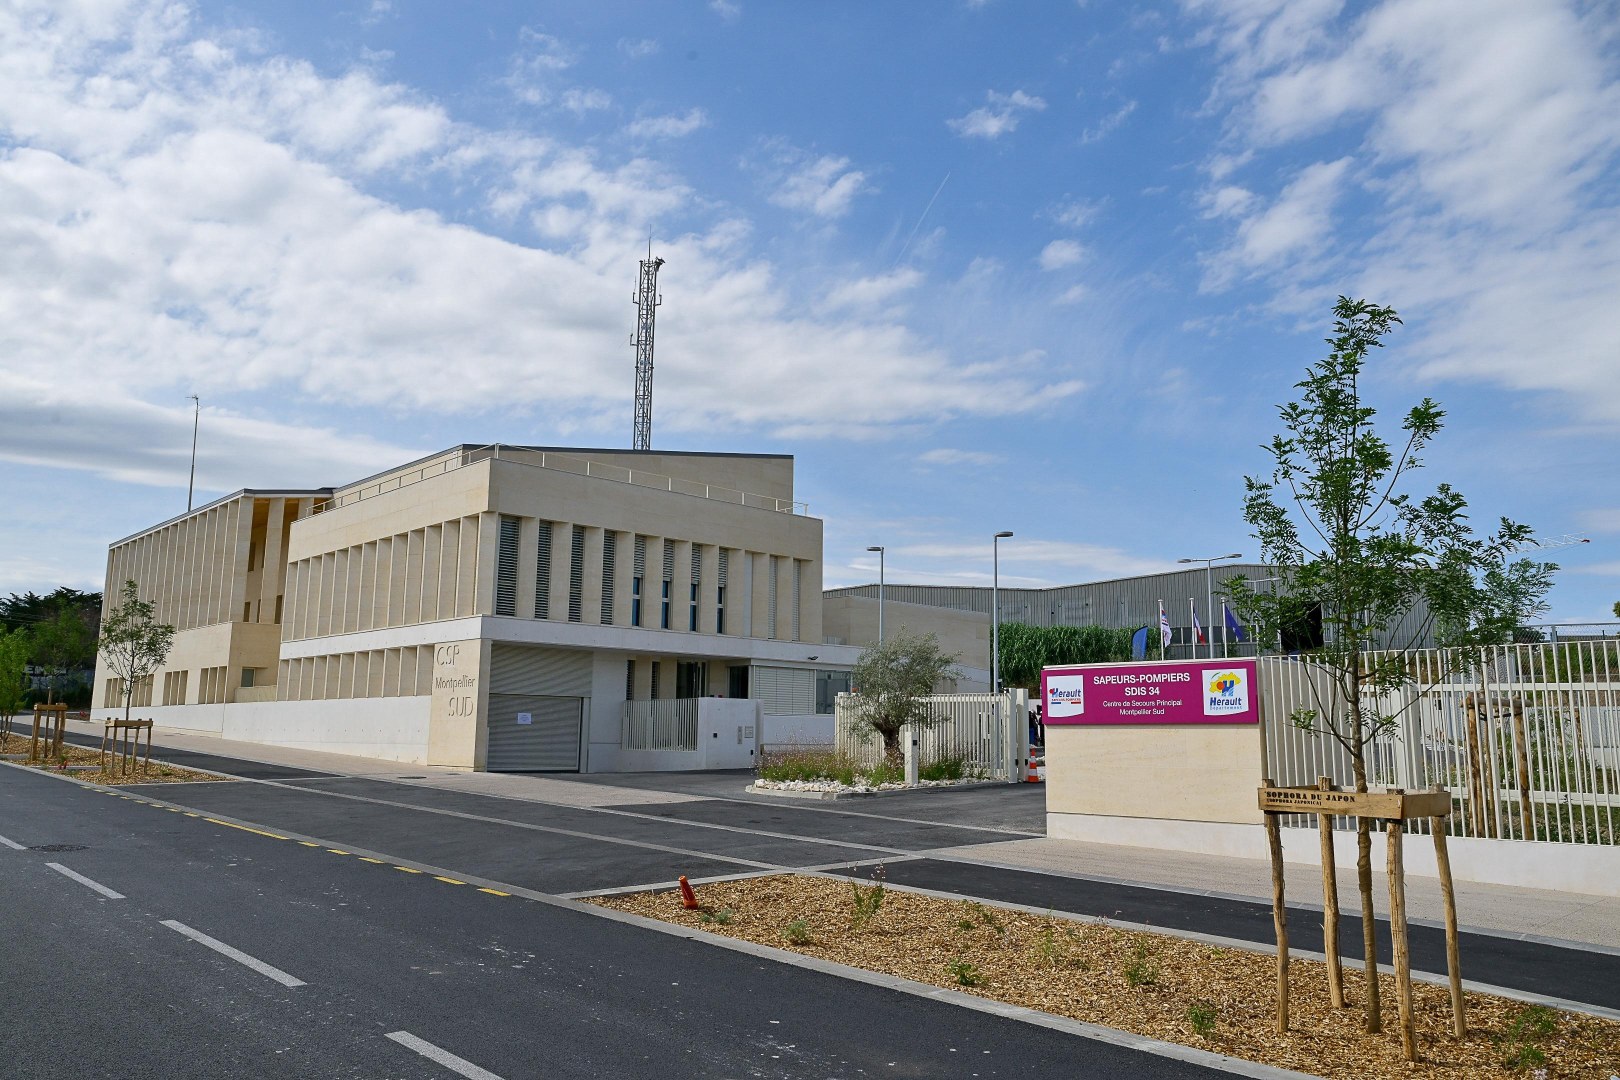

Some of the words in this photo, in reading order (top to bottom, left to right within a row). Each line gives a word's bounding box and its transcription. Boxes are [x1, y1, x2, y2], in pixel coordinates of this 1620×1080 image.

[437, 645, 460, 666] CSP
[435, 674, 476, 693] Montpellier
[1093, 672, 1191, 685] SAPEURS-POMPIERS
[1124, 686, 1147, 696] SDIS
[1148, 686, 1160, 696] 34
[448, 696, 474, 718] SUD
[1102, 700, 1122, 708] Centre
[1131, 699, 1156, 707] Secours
[1156, 698, 1183, 708] Principal
[1119, 708, 1152, 716] Montpellier
[1152, 707, 1165, 715] Sud
[1310, 793, 1323, 801] DU
[1325, 794, 1356, 803] JAPON
